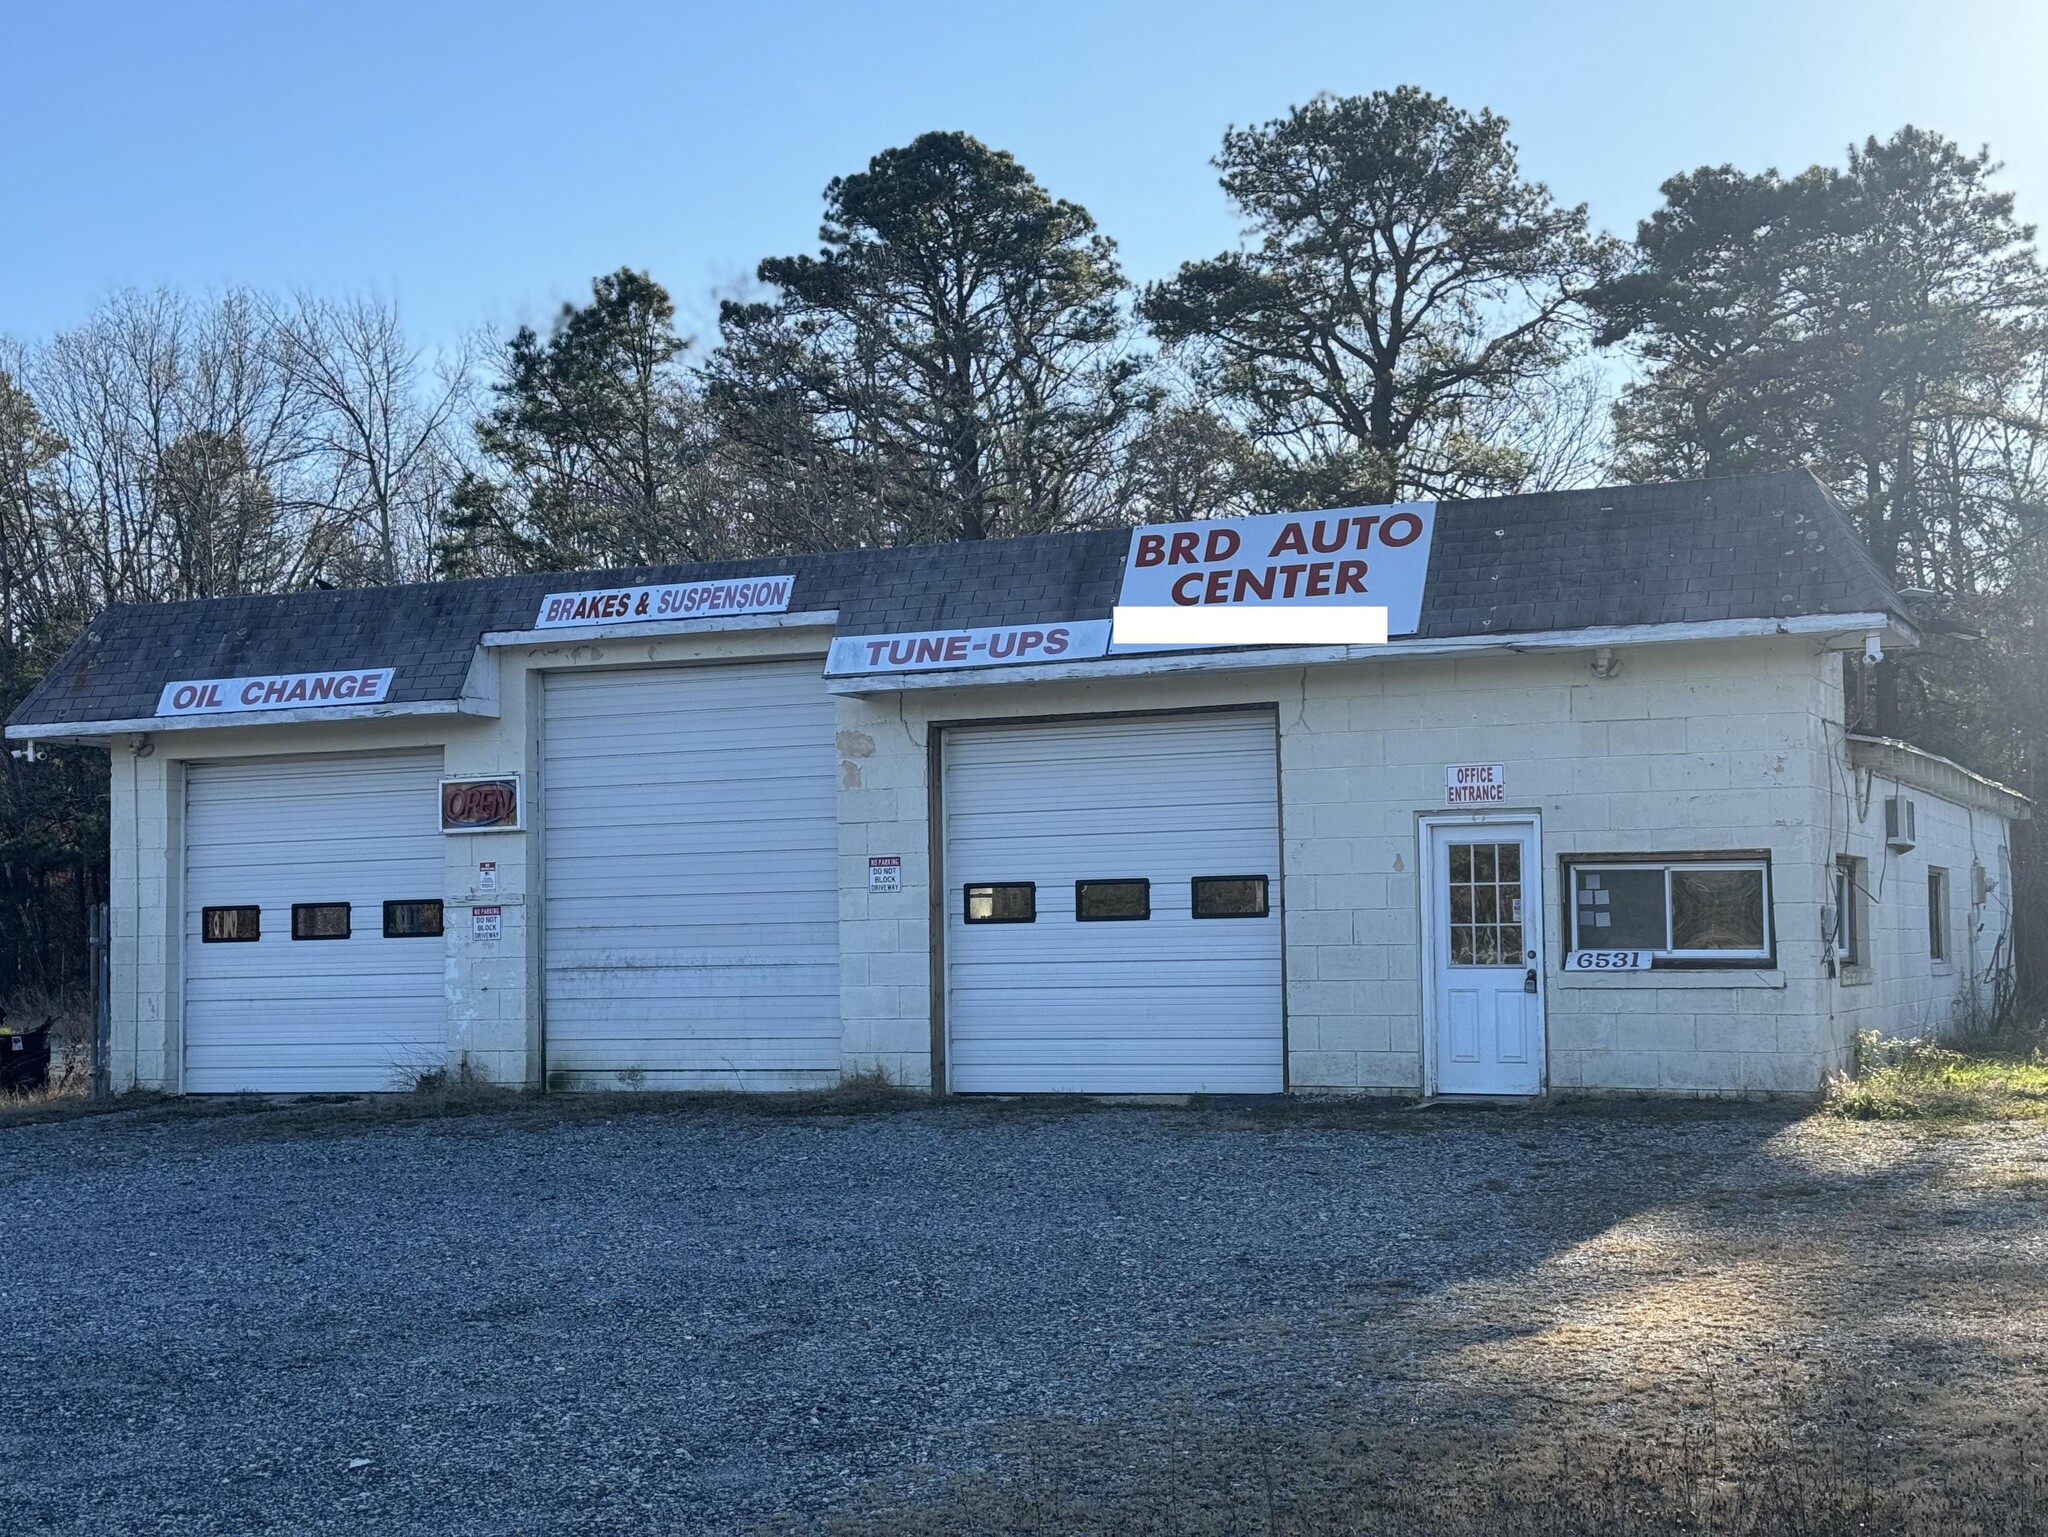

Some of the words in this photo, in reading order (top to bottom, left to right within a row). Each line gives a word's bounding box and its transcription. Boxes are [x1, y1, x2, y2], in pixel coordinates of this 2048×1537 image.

[1134, 528, 1241, 568] BRD
[1267, 512, 1423, 557] AUTO
[545, 592, 631, 622] BRAKES
[634, 591, 650, 616] &
[657, 581, 787, 614] SUSPENSION
[1171, 560, 1369, 606] CENTER
[866, 628, 1070, 666] TUNE-UPS
[172, 684, 223, 710] OIL
[240, 673, 383, 706] CHANGE
[1448, 784, 1503, 802] ENTRANCE
[1457, 766, 1493, 784] OFFICE
[445, 788, 513, 819] OPEN
[1576, 952, 1640, 969] 6531
